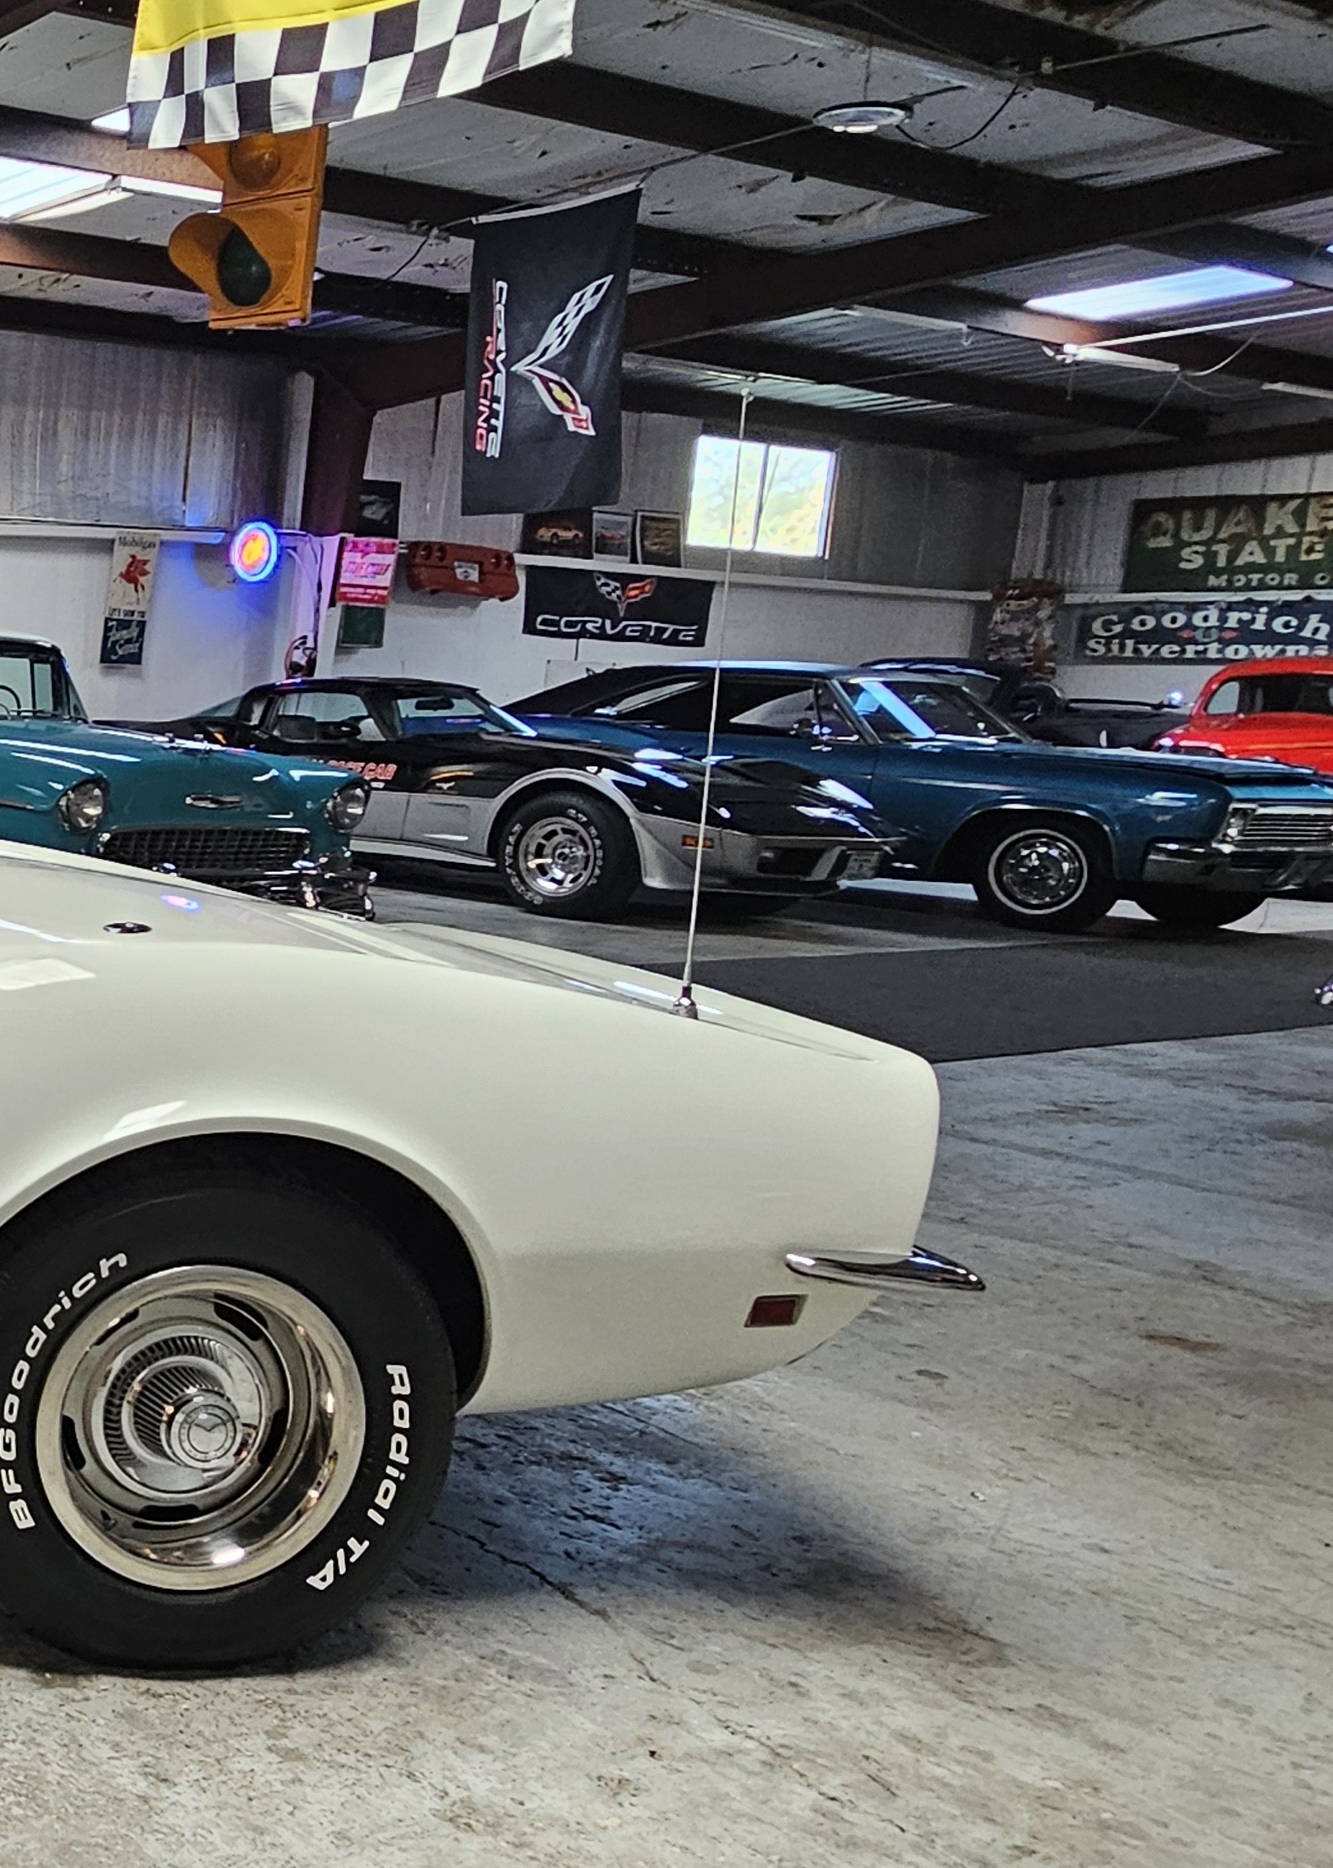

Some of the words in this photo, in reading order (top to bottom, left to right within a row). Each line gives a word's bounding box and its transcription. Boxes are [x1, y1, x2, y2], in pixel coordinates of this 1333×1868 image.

[486, 281, 508, 458] CORVETTE
[475, 336, 496, 452] RACING
[1178, 536, 1326, 569] STATE
[1207, 572, 1300, 587] MOTOR
[536, 614, 699, 641] CORVETTE
[1091, 606, 1331, 641] Goodrich
[1085, 638, 1330, 659] Silvertowns
[367, 1364, 412, 1527] Radial
[305, 1536, 371, 1592] T/A
